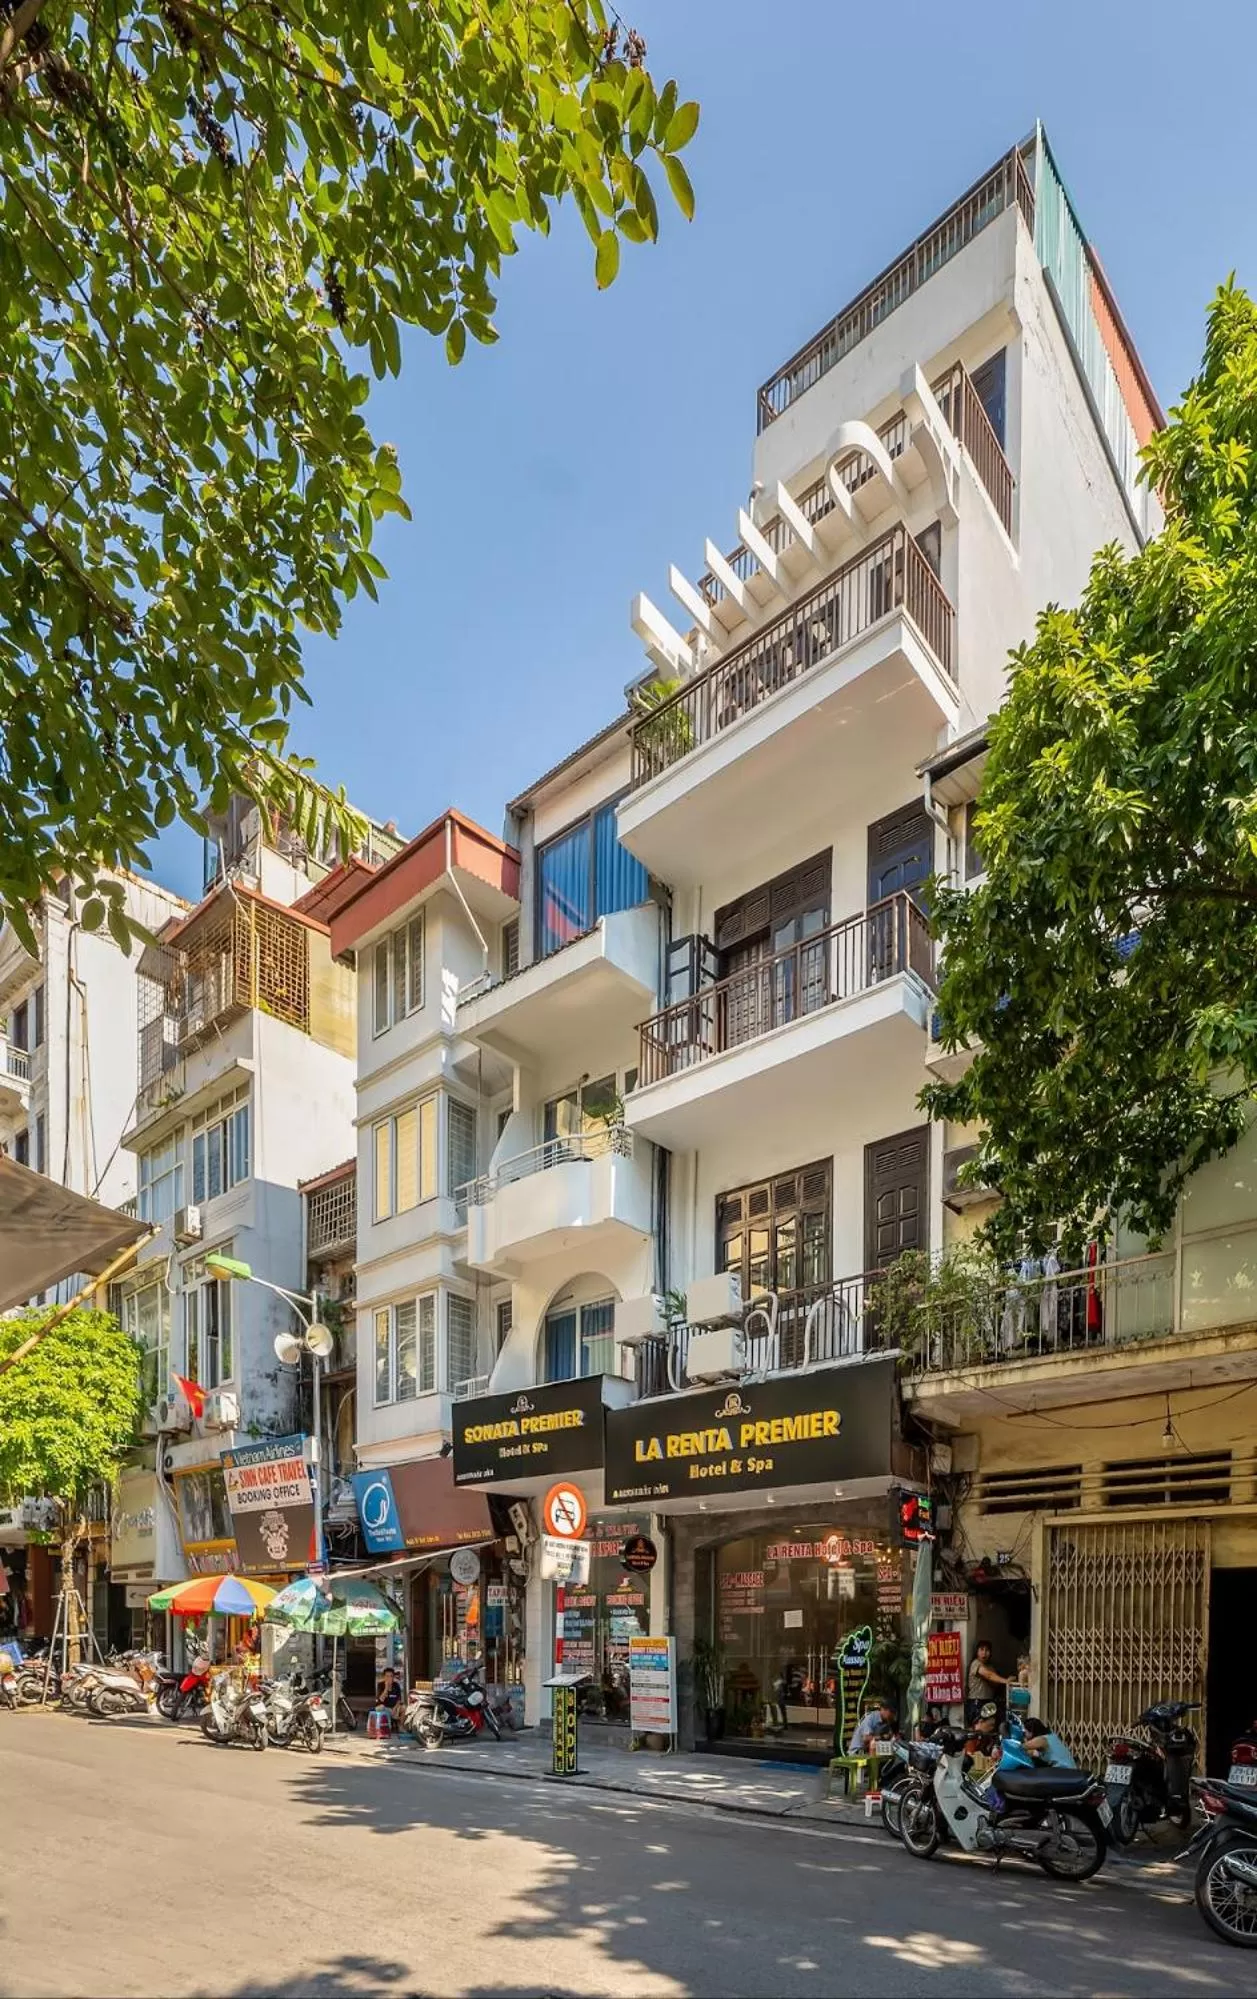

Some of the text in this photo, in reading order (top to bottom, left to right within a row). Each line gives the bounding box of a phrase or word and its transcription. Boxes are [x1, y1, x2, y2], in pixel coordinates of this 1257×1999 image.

[464, 1409, 584, 1444] SONATA PREMIER
[635, 1410, 842, 1462] LA RENTA PREMIER
[234, 1444, 295, 1467] Vietnam Airlines
[499, 1445, 522, 1458] Hotel
[258, 1465, 278, 1486] CAFE
[278, 1459, 306, 1483] TRAVEL
[689, 1457, 773, 1479] Hotel & Spa
[237, 1484, 301, 1504] BOOKING OFFICE
[767, 1545, 778, 1560] LA
[781, 1542, 812, 1559] RENTA
[852, 1539, 874, 1555] Spa
[853, 1638, 869, 1653] Spa
